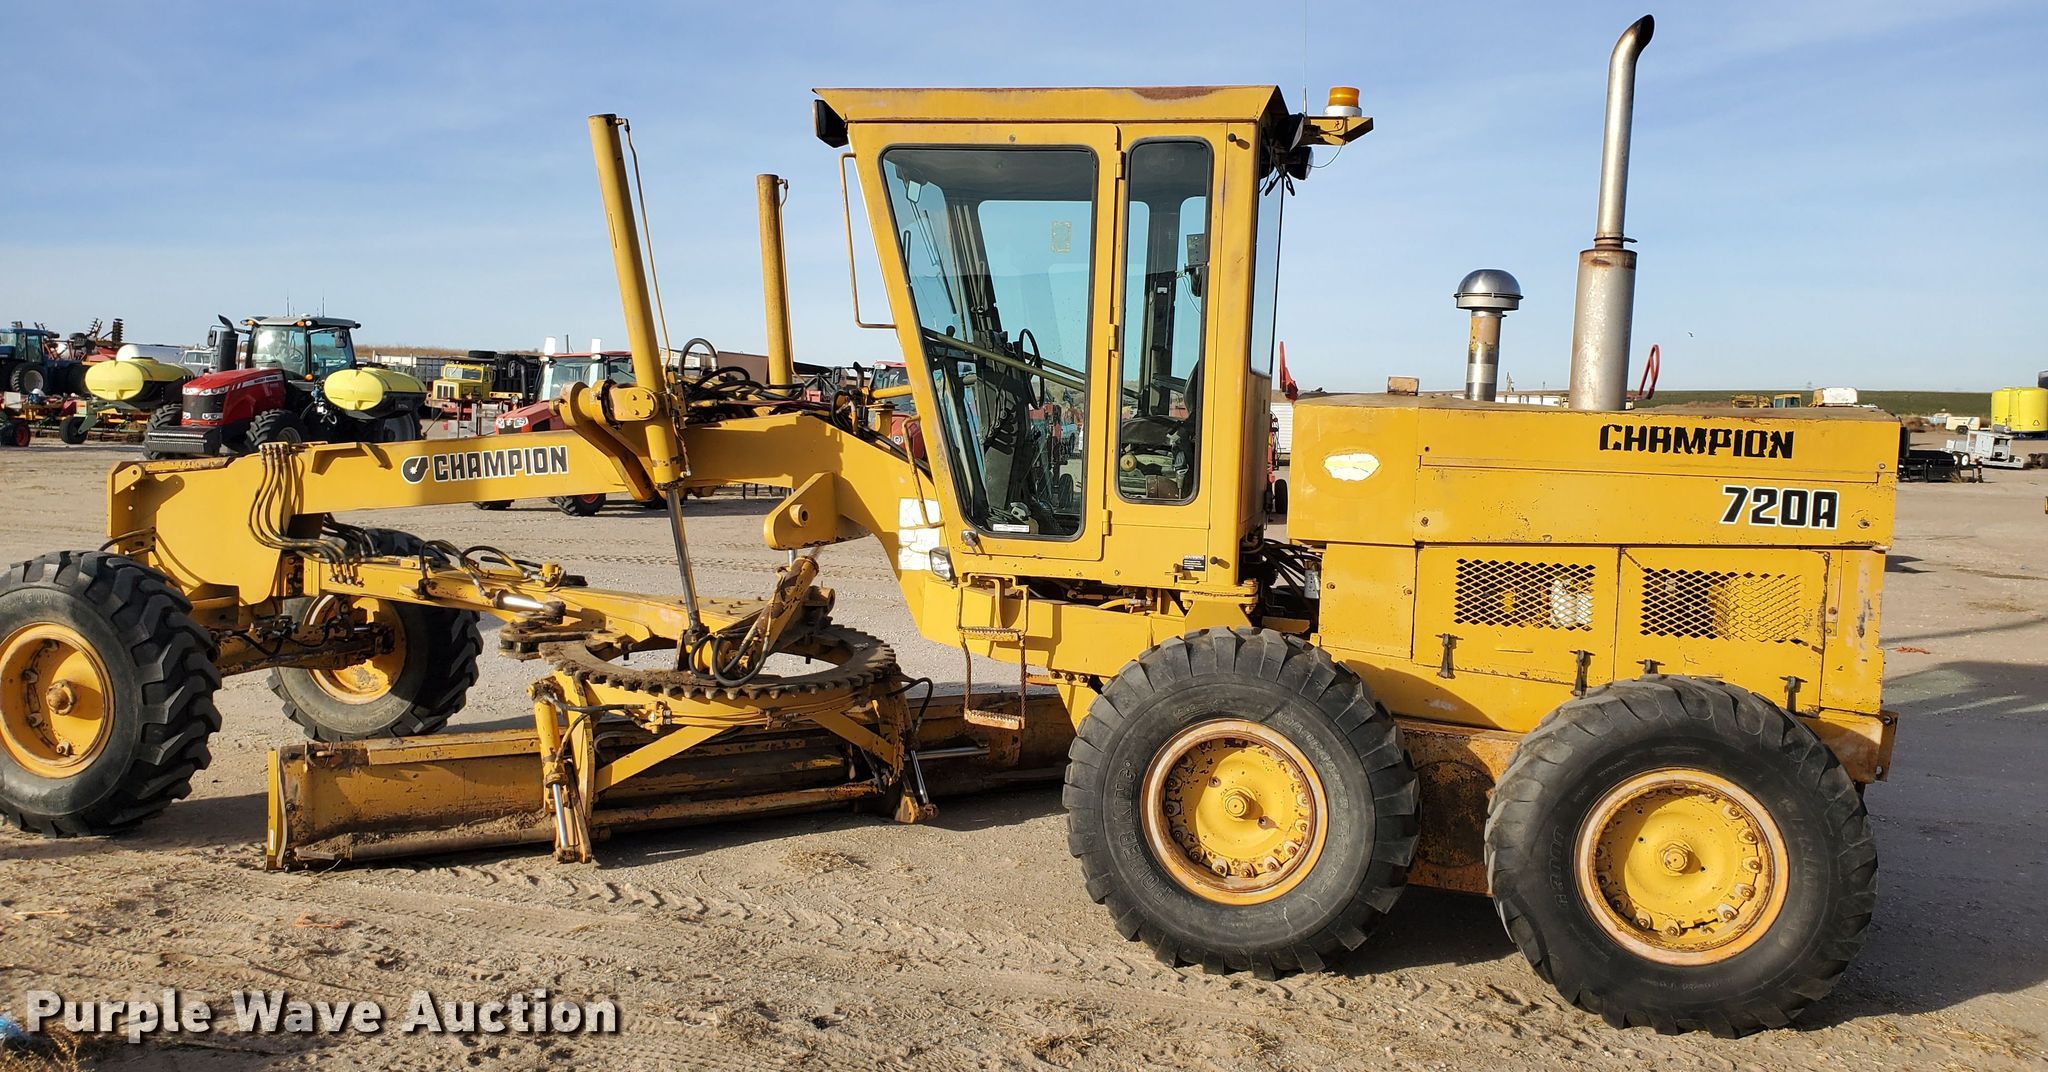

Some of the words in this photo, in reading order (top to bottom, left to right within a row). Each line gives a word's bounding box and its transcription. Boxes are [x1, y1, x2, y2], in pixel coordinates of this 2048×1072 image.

[1600, 423, 1794, 459] CHAMPION
[433, 445, 569, 481] CHAMPION
[1719, 485, 1839, 529] 720A
